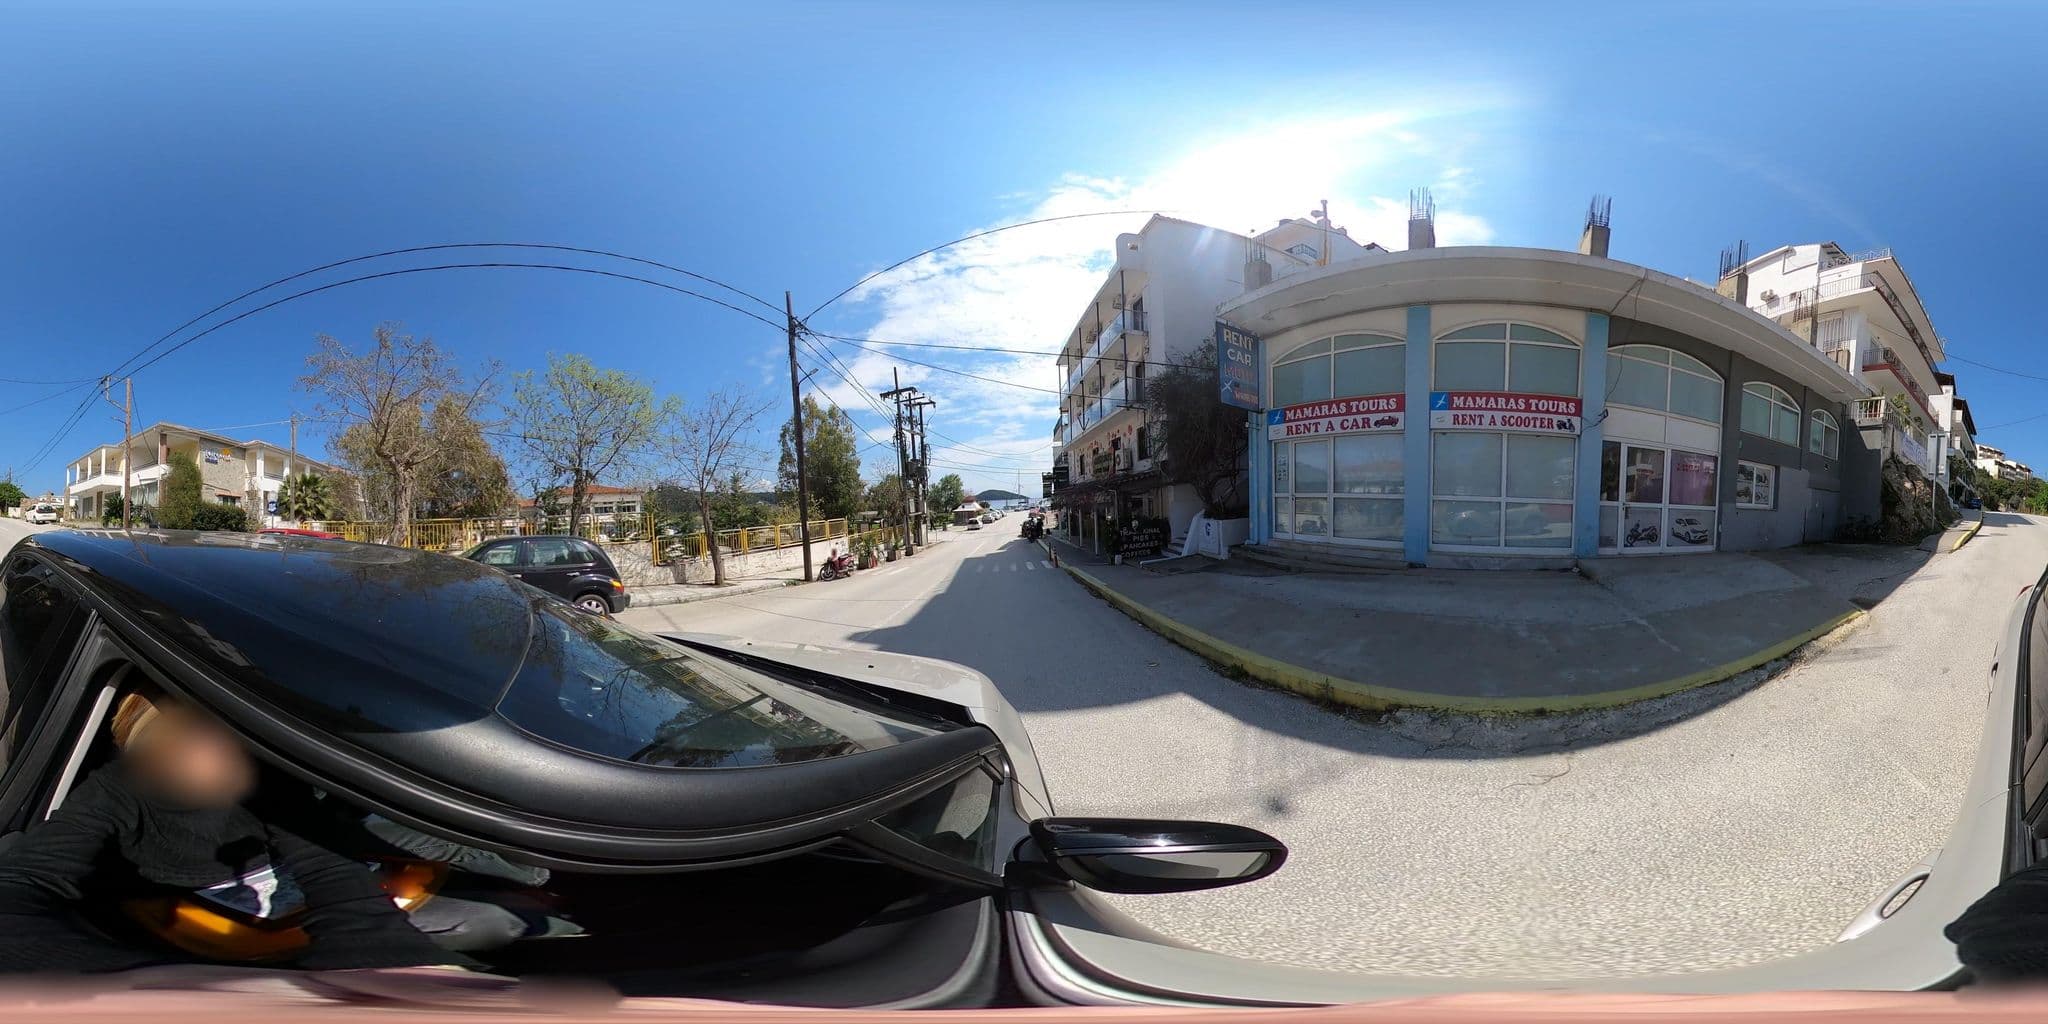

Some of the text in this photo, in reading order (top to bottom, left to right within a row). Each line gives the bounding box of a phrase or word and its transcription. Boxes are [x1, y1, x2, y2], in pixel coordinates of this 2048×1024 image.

[1223, 328, 1254, 351] RENT
[1227, 348, 1252, 367] CAR
[1285, 398, 1397, 420] MAMARAS TOURS
[1452, 396, 1576, 414] MAMARAS TOURS
[1286, 416, 1371, 436] RENT A CAR
[1452, 413, 1554, 429] RENT A SCOOTER
